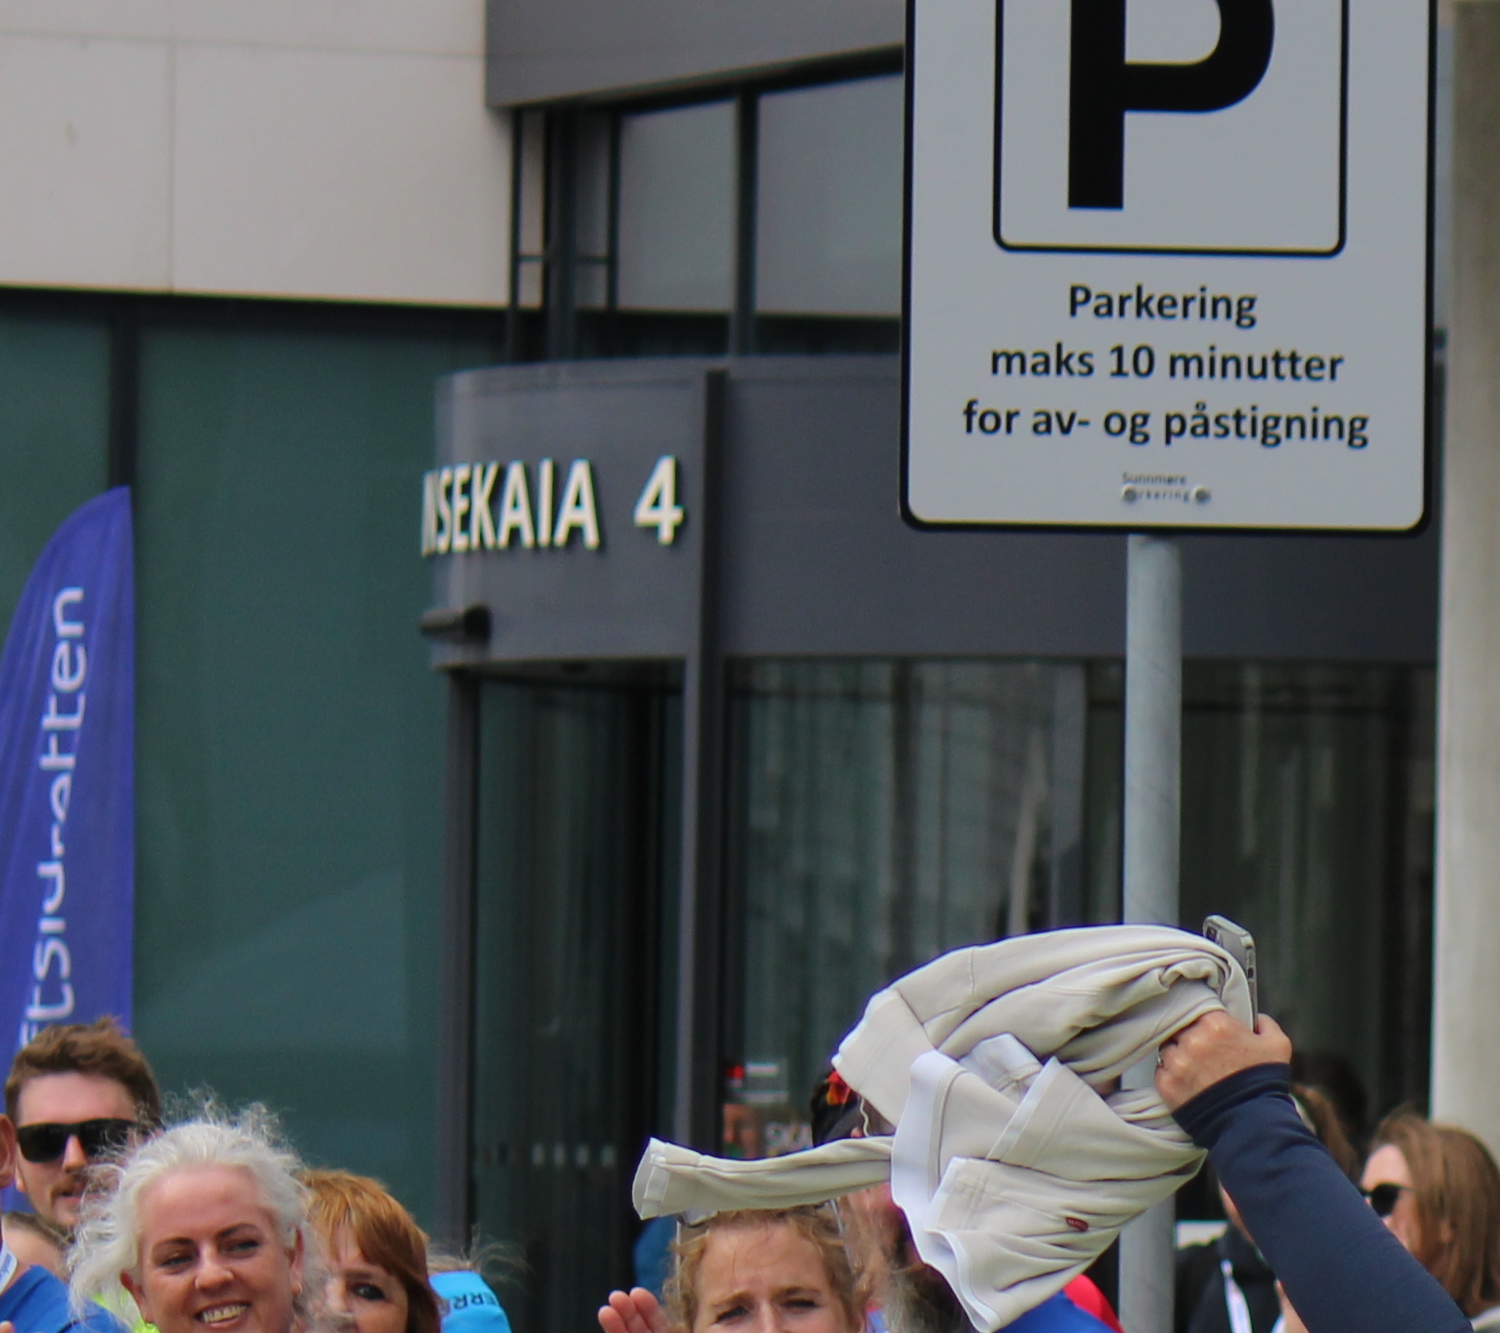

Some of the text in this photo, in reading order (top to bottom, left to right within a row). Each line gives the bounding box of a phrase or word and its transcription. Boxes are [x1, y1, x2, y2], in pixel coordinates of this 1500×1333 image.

[1068, 0, 1274, 210] P
[1069, 284, 1257, 329] Parkering
[991, 341, 1344, 381] maks 10 minutter
[963, 400, 1369, 449] for av- og påstigning
[633, 454, 684, 545] 4
